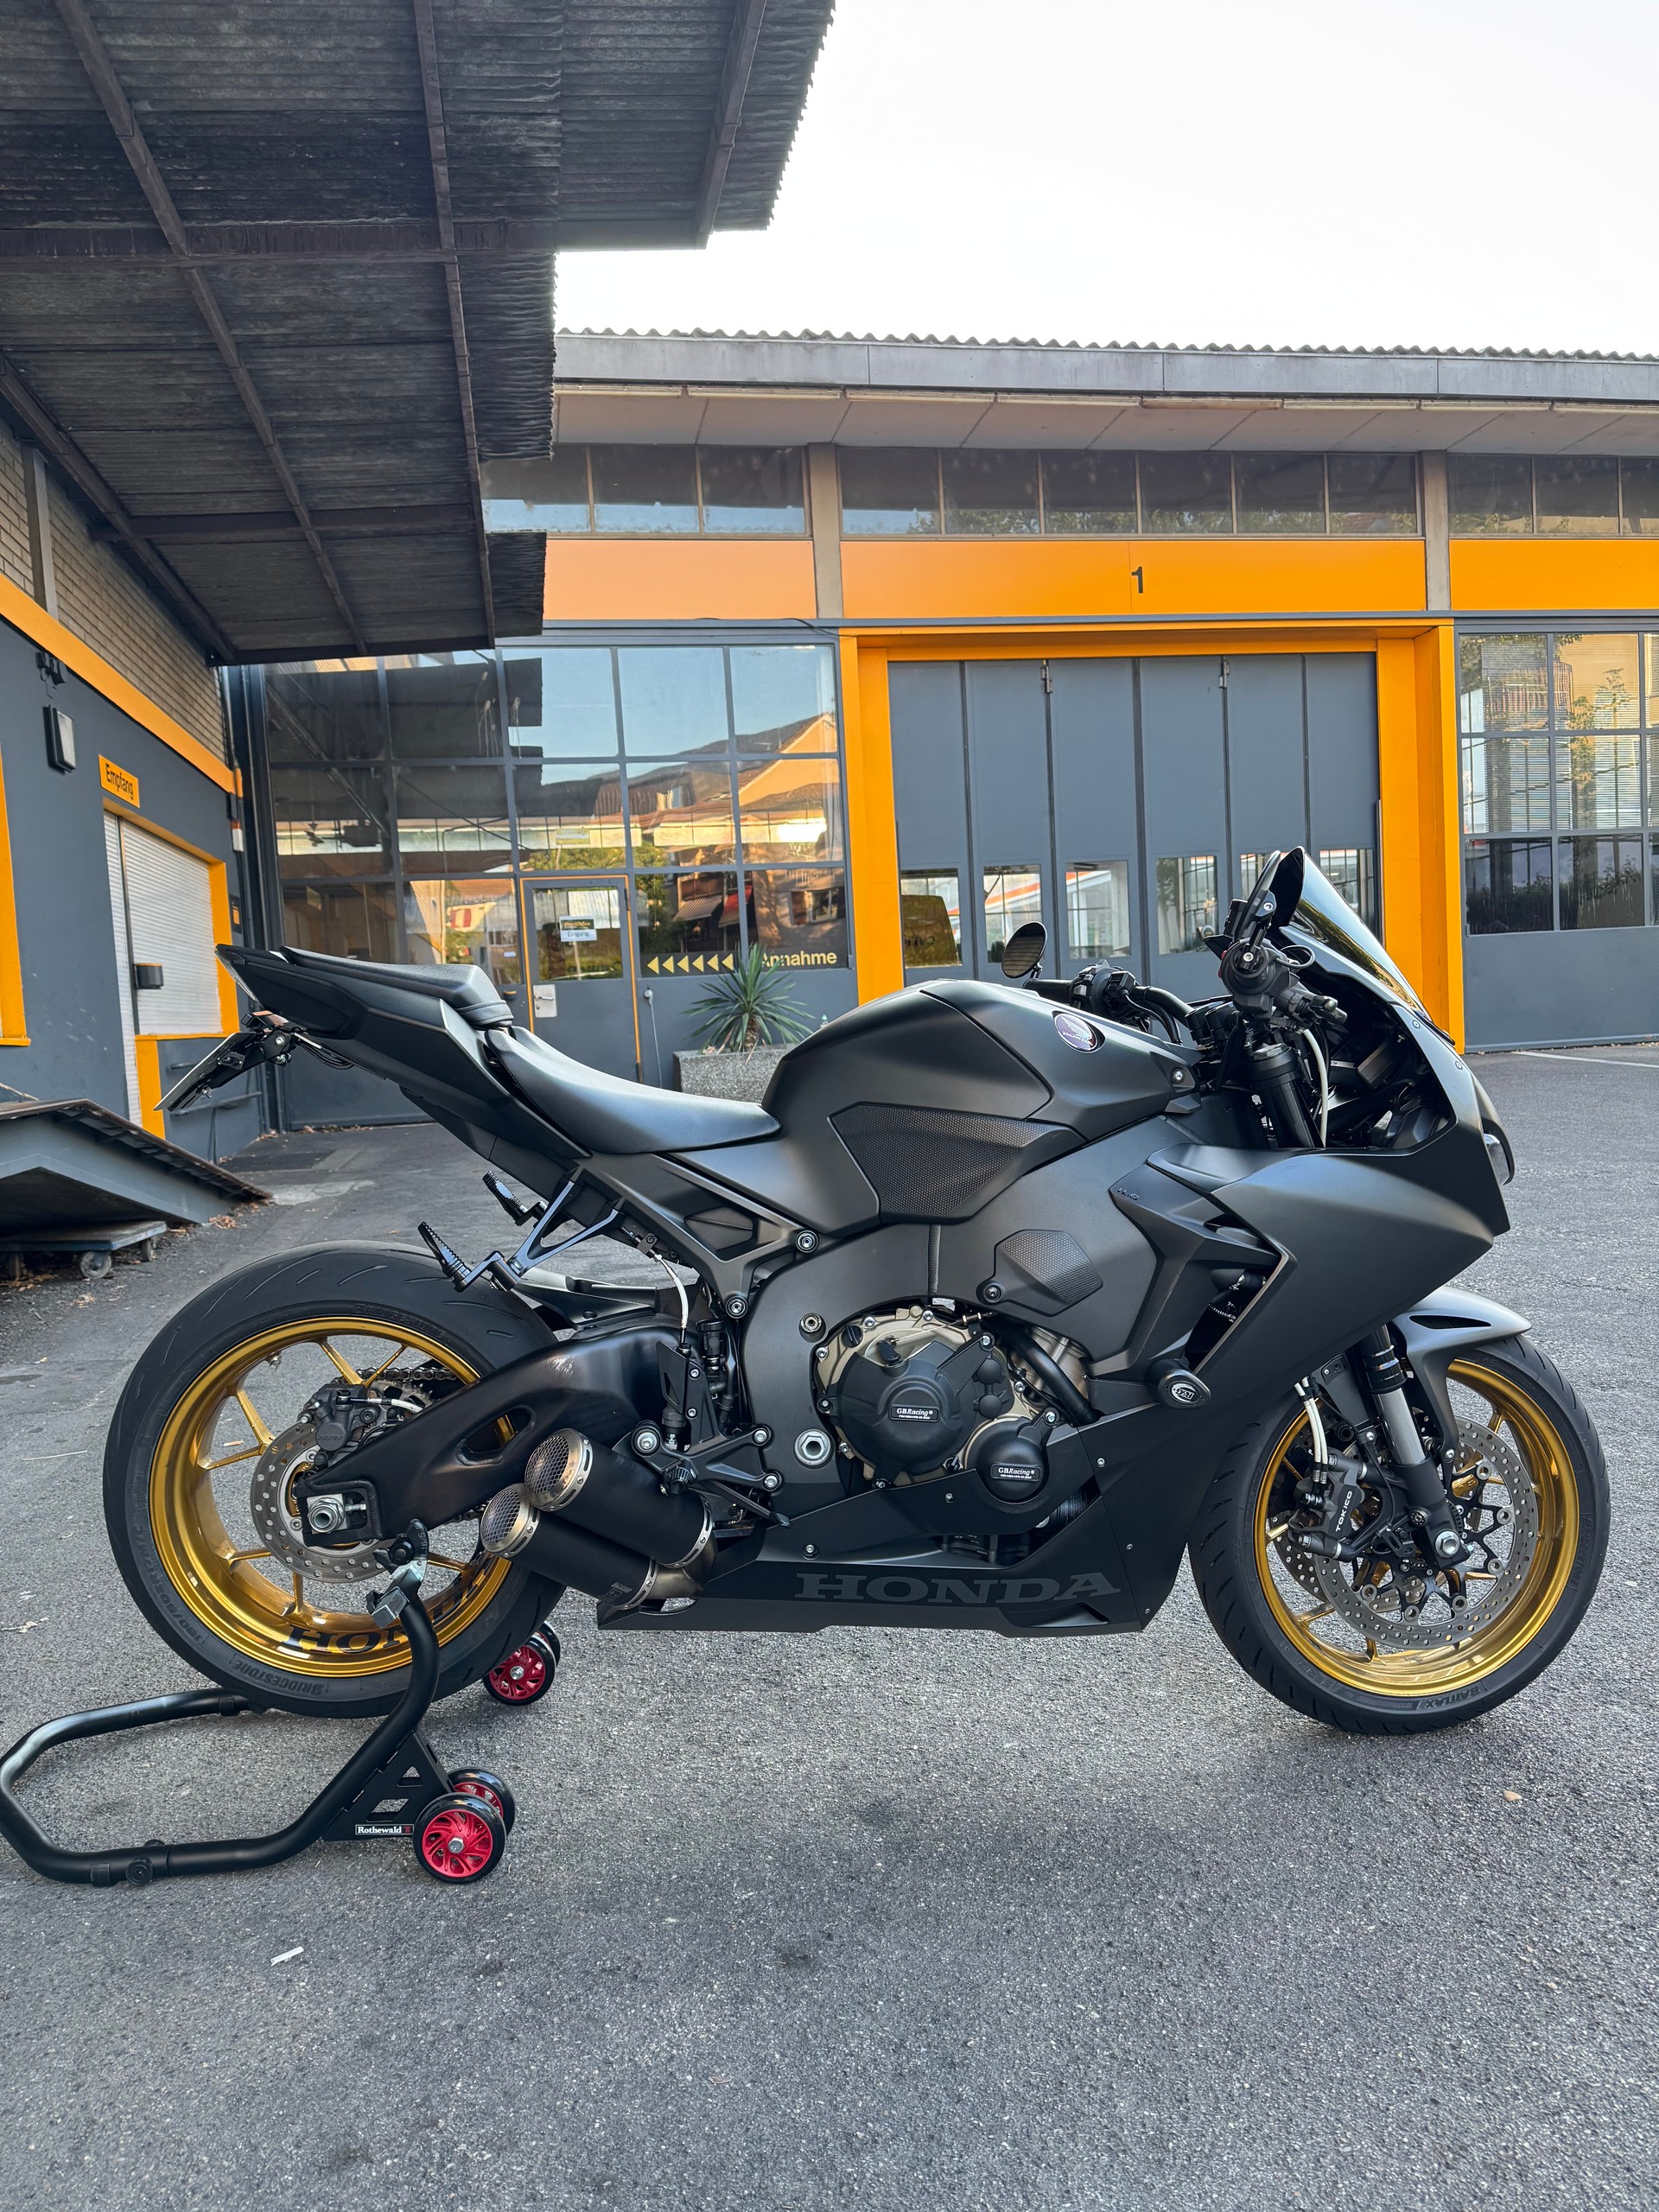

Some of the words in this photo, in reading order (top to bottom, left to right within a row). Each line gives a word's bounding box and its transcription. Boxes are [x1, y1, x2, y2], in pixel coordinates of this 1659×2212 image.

[1131, 566, 1143, 594] 1
[105, 763, 134, 800] Empfang
[1335, 1491, 1352, 1532] TOKICO
[794, 1572, 1122, 1605] HONDA
[232, 1659, 326, 1695] BRIDGESTONE
